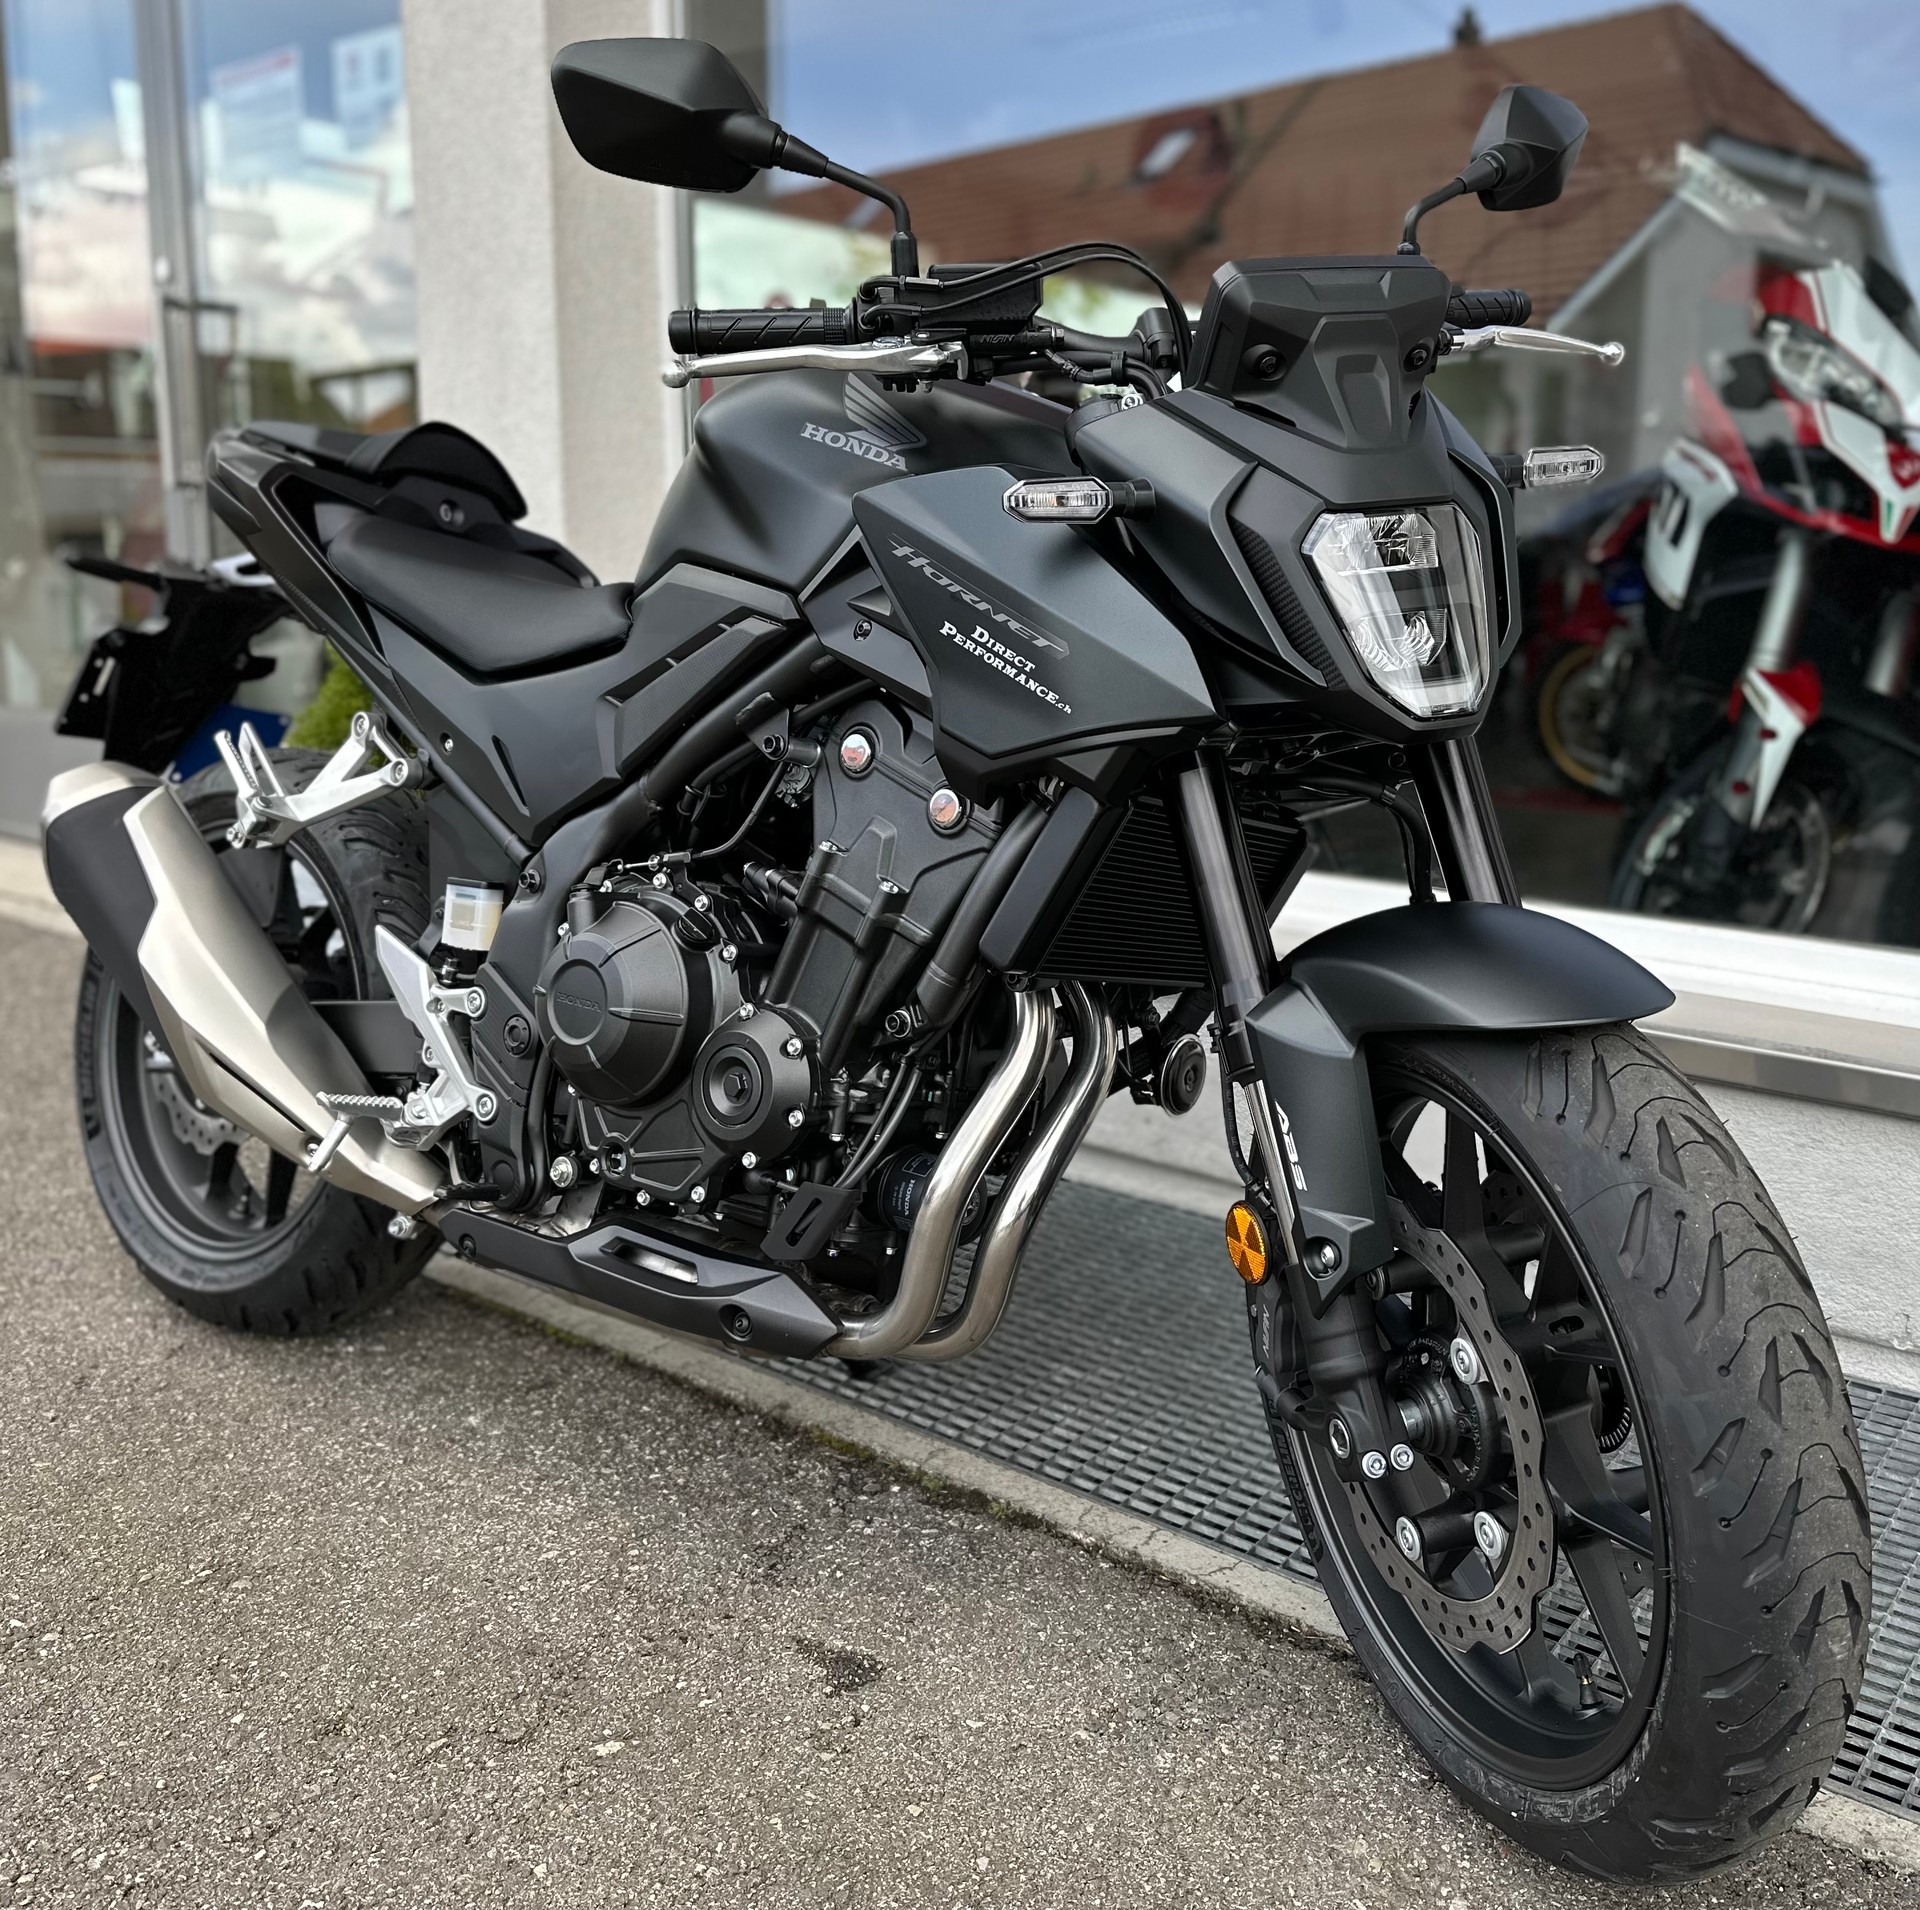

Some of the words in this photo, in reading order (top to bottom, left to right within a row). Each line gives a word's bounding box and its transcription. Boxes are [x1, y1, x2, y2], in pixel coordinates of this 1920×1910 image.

[801, 422, 908, 471] HONDA
[888, 538, 1065, 652] HORNET
[556, 991, 602, 1013] HONDA
[1275, 1100, 1308, 1192] ABS
[904, 1179, 916, 1216] HONDA
